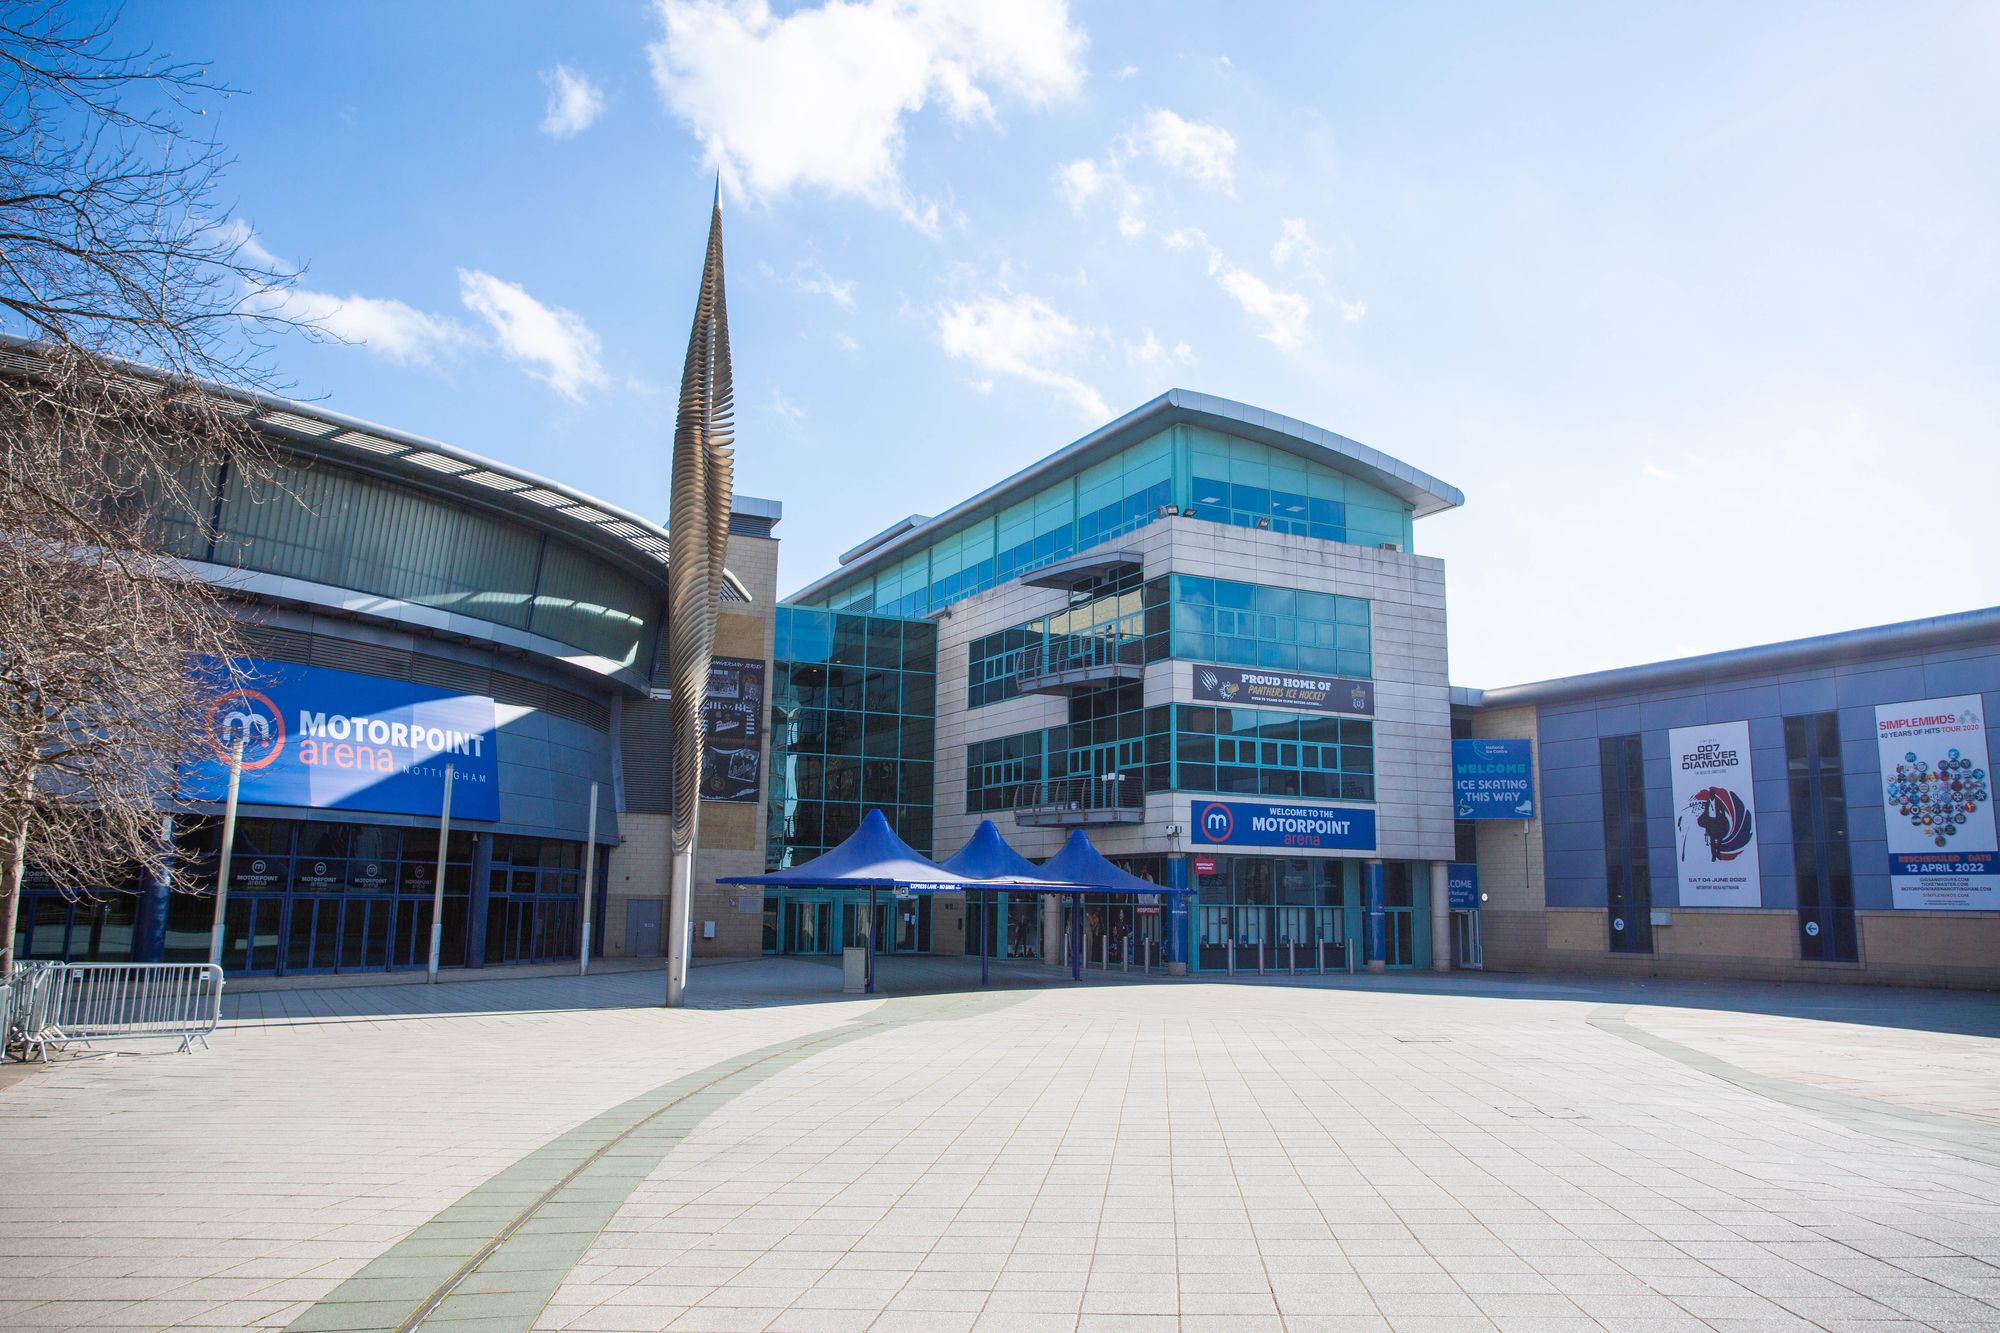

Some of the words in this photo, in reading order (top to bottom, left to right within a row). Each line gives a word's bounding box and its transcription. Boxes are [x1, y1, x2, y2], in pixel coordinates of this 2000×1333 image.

[1241, 674, 1280, 686] PROUD
[1283, 678, 1316, 690] HOME
[1318, 682, 1331, 691] OF
[1248, 685, 1284, 697] PANTHERS
[1286, 688, 1297, 698] ICE
[1298, 690, 1326, 700] HOCKEY
[300, 710, 484, 758] MOTORPOINT
[1889, 729, 1912, 738] YEARS
[1698, 744, 1720, 752] 007
[299, 740, 394, 772] arena
[1683, 750, 1736, 762] FOREVER
[1457, 764, 1526, 774] WELCOME
[1682, 758, 1738, 770] DIAMOND
[403, 765, 486, 782] NOTTIGHAM
[1457, 780, 1475, 789] ICE
[1478, 780, 1527, 789] SKATING
[1465, 792, 1490, 801] THIS
[1493, 792, 1520, 801] WAY
[1269, 808, 1307, 817] WELCOME
[1308, 809, 1318, 817] TO
[1319, 810, 1334, 818] THE
[1252, 817, 1350, 835] MOTORPOINT
[1284, 834, 1320, 846] arena
[1906, 864, 1918, 872] 12
[1921, 863, 1952, 872] APRIL
[1955, 863, 1984, 872] 2022
[1448, 880, 1472, 888] COME
